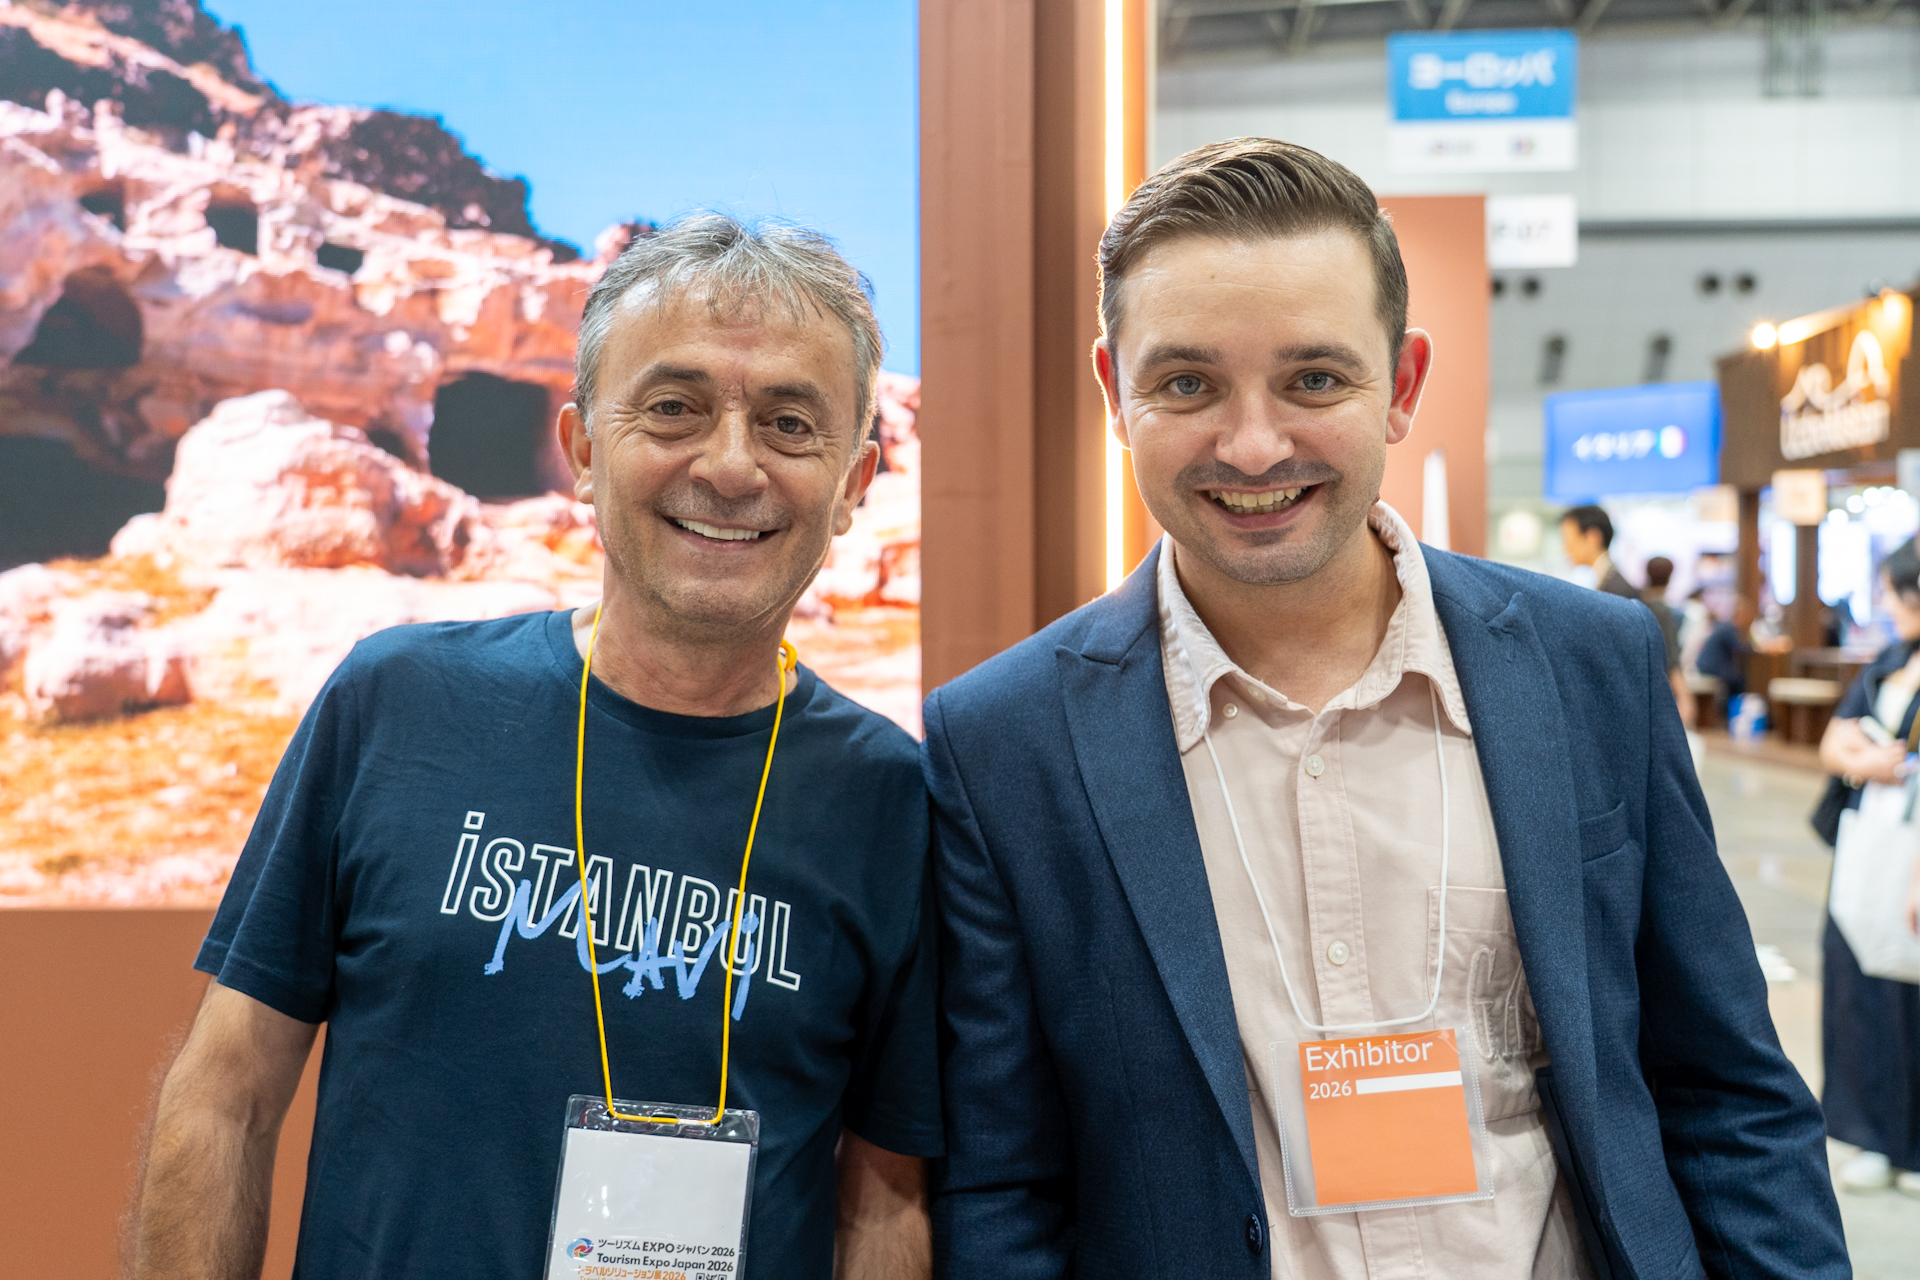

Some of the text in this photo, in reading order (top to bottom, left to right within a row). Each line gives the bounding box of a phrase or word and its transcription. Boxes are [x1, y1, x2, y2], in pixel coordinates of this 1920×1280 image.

[1305, 1039, 1434, 1072] Exhibitor
[1309, 1079, 1352, 1099] 2026
[710, 1246, 735, 1257] 2026
[597, 1252, 734, 1272] Tourism Expo Japan 2026
